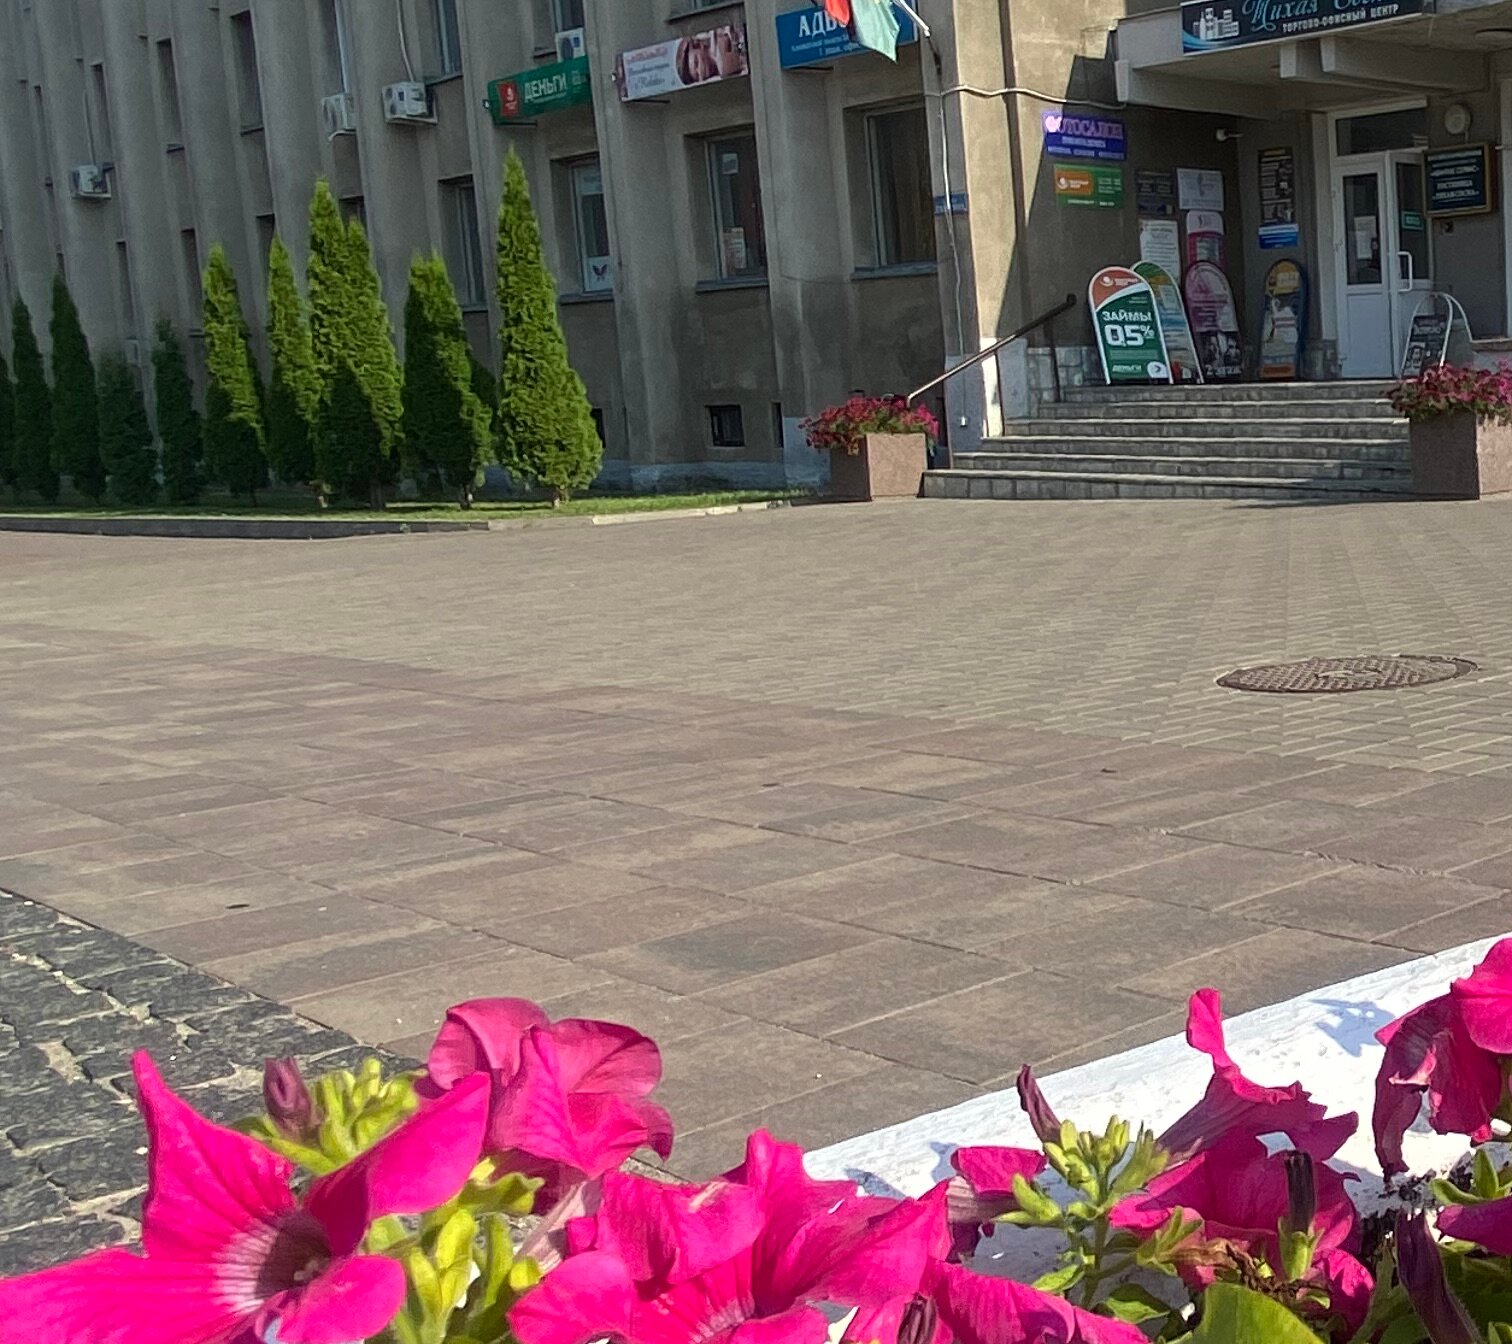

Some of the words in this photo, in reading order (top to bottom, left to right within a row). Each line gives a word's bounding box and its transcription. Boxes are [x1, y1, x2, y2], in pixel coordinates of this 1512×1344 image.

[1282, 8, 1366, 34] ТОРГОВО-ОФИСНЫЙ
[1370, 4, 1400, 19] ЦЕНТР
[524, 72, 569, 104] ДЕНЬГИ
[1102, 309, 1153, 322] ЗАЙМЫ
